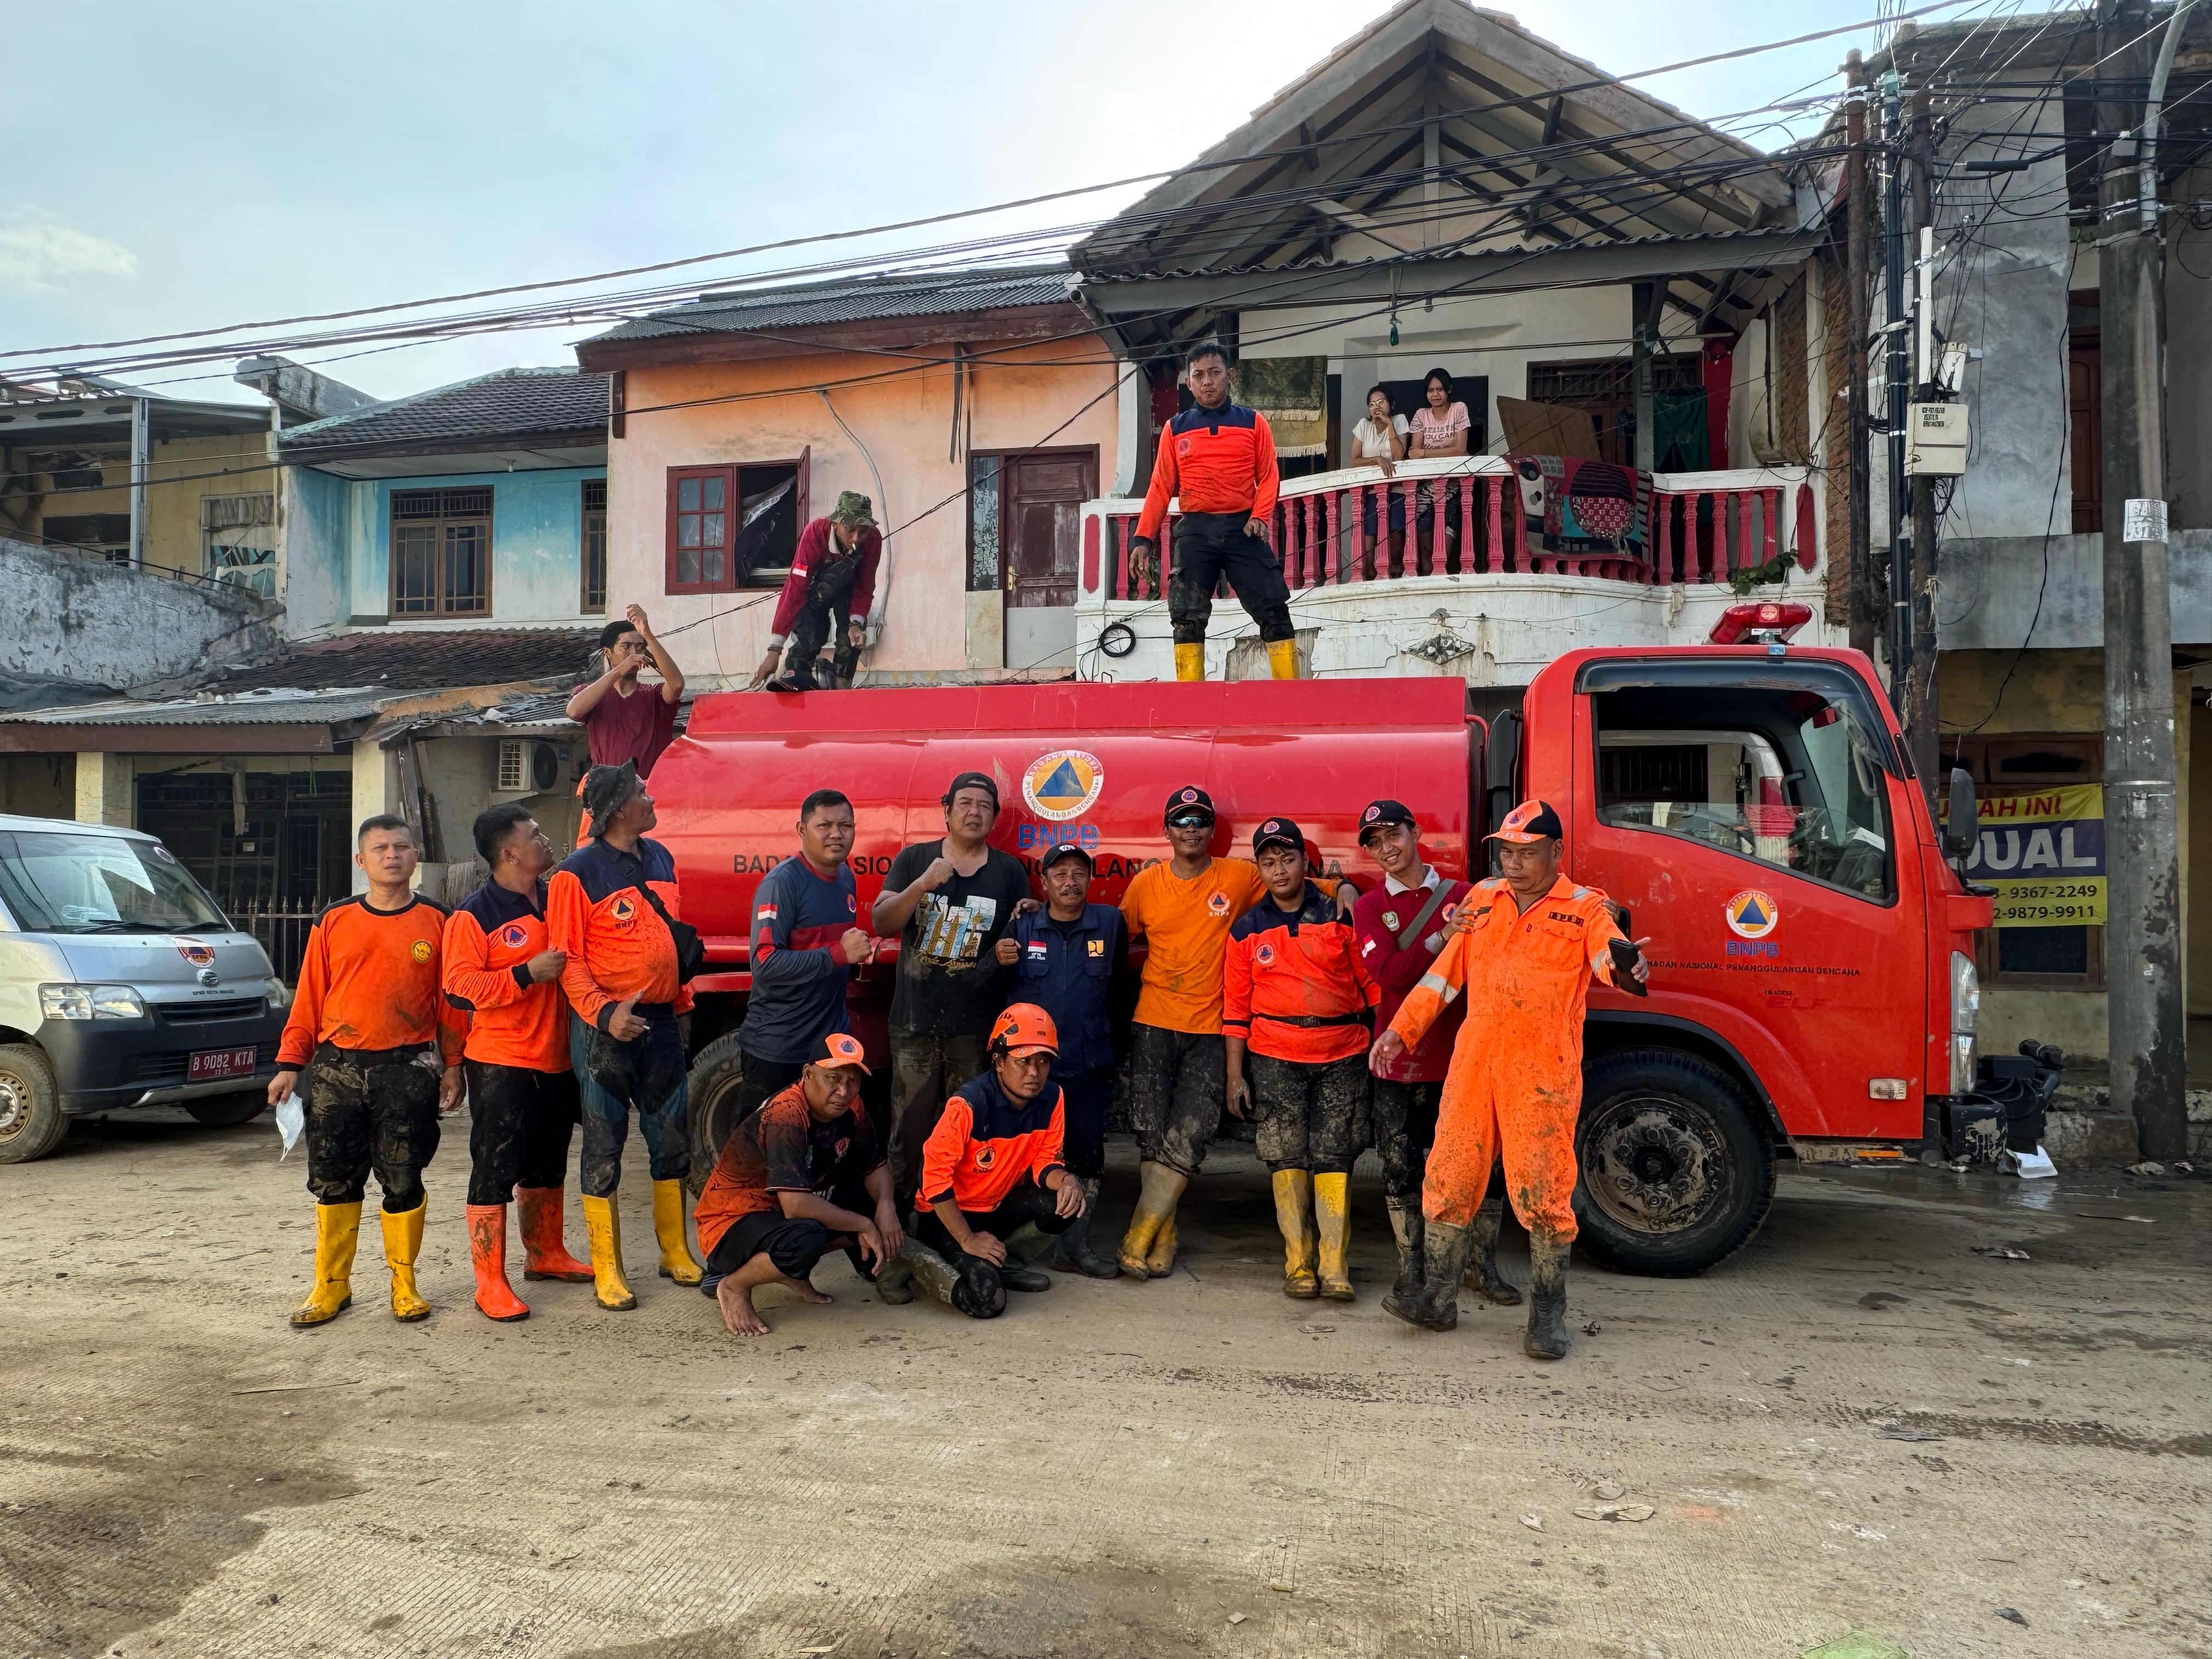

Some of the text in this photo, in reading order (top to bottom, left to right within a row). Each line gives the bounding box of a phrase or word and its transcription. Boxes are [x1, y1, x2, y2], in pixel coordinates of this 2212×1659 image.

[2024, 795, 2061, 816] INI
[1018, 823, 1099, 850] BNPB
[2010, 885, 2097, 899] 9367-2249
[1726, 940, 1779, 957] BNPB
[1680, 962, 1724, 970] NASIONAL
[193, 1057, 200, 1071] B
[234, 1051, 253, 1066] KTA
